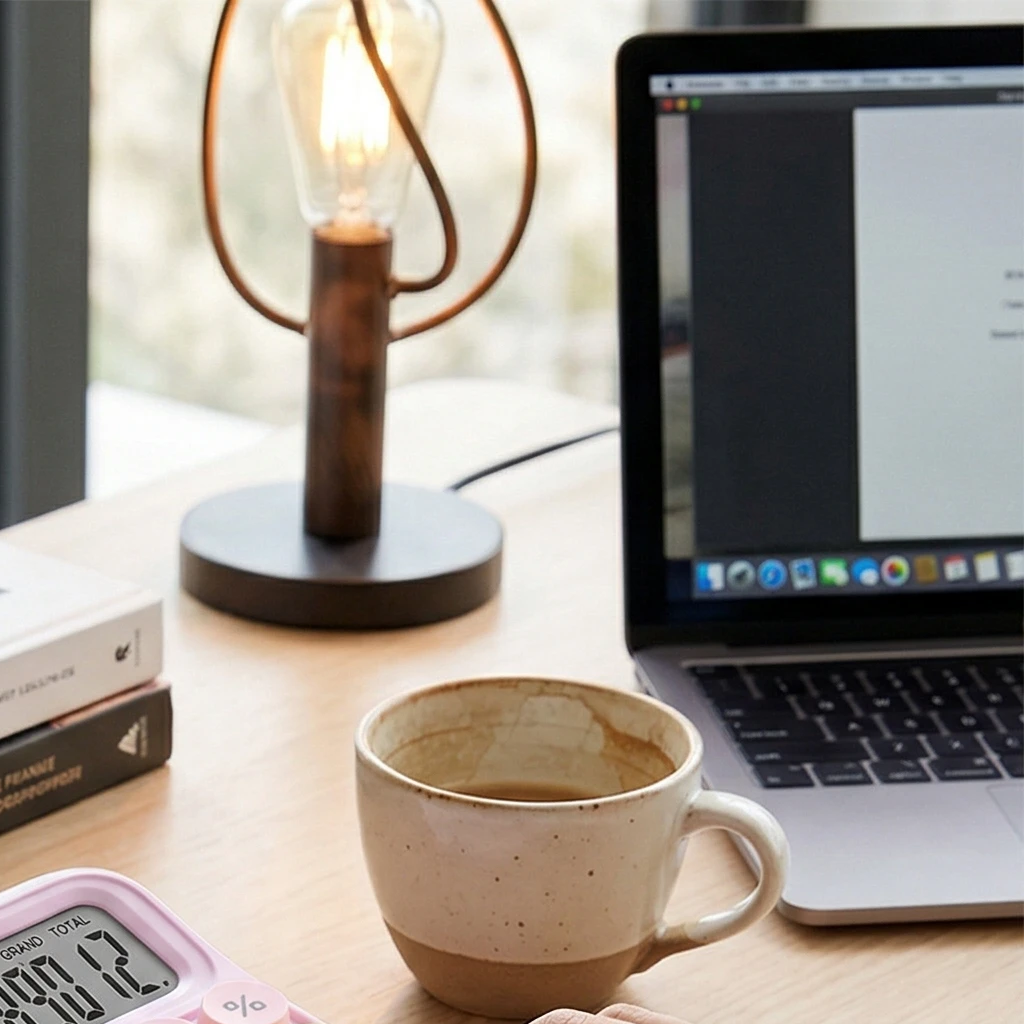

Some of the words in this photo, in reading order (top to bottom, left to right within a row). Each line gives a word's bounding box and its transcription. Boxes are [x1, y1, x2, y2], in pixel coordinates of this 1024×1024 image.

[0, 935, 44, 960] GRAND
[48, 915, 91, 938] TOTAL
[222, 994, 267, 1017] %
